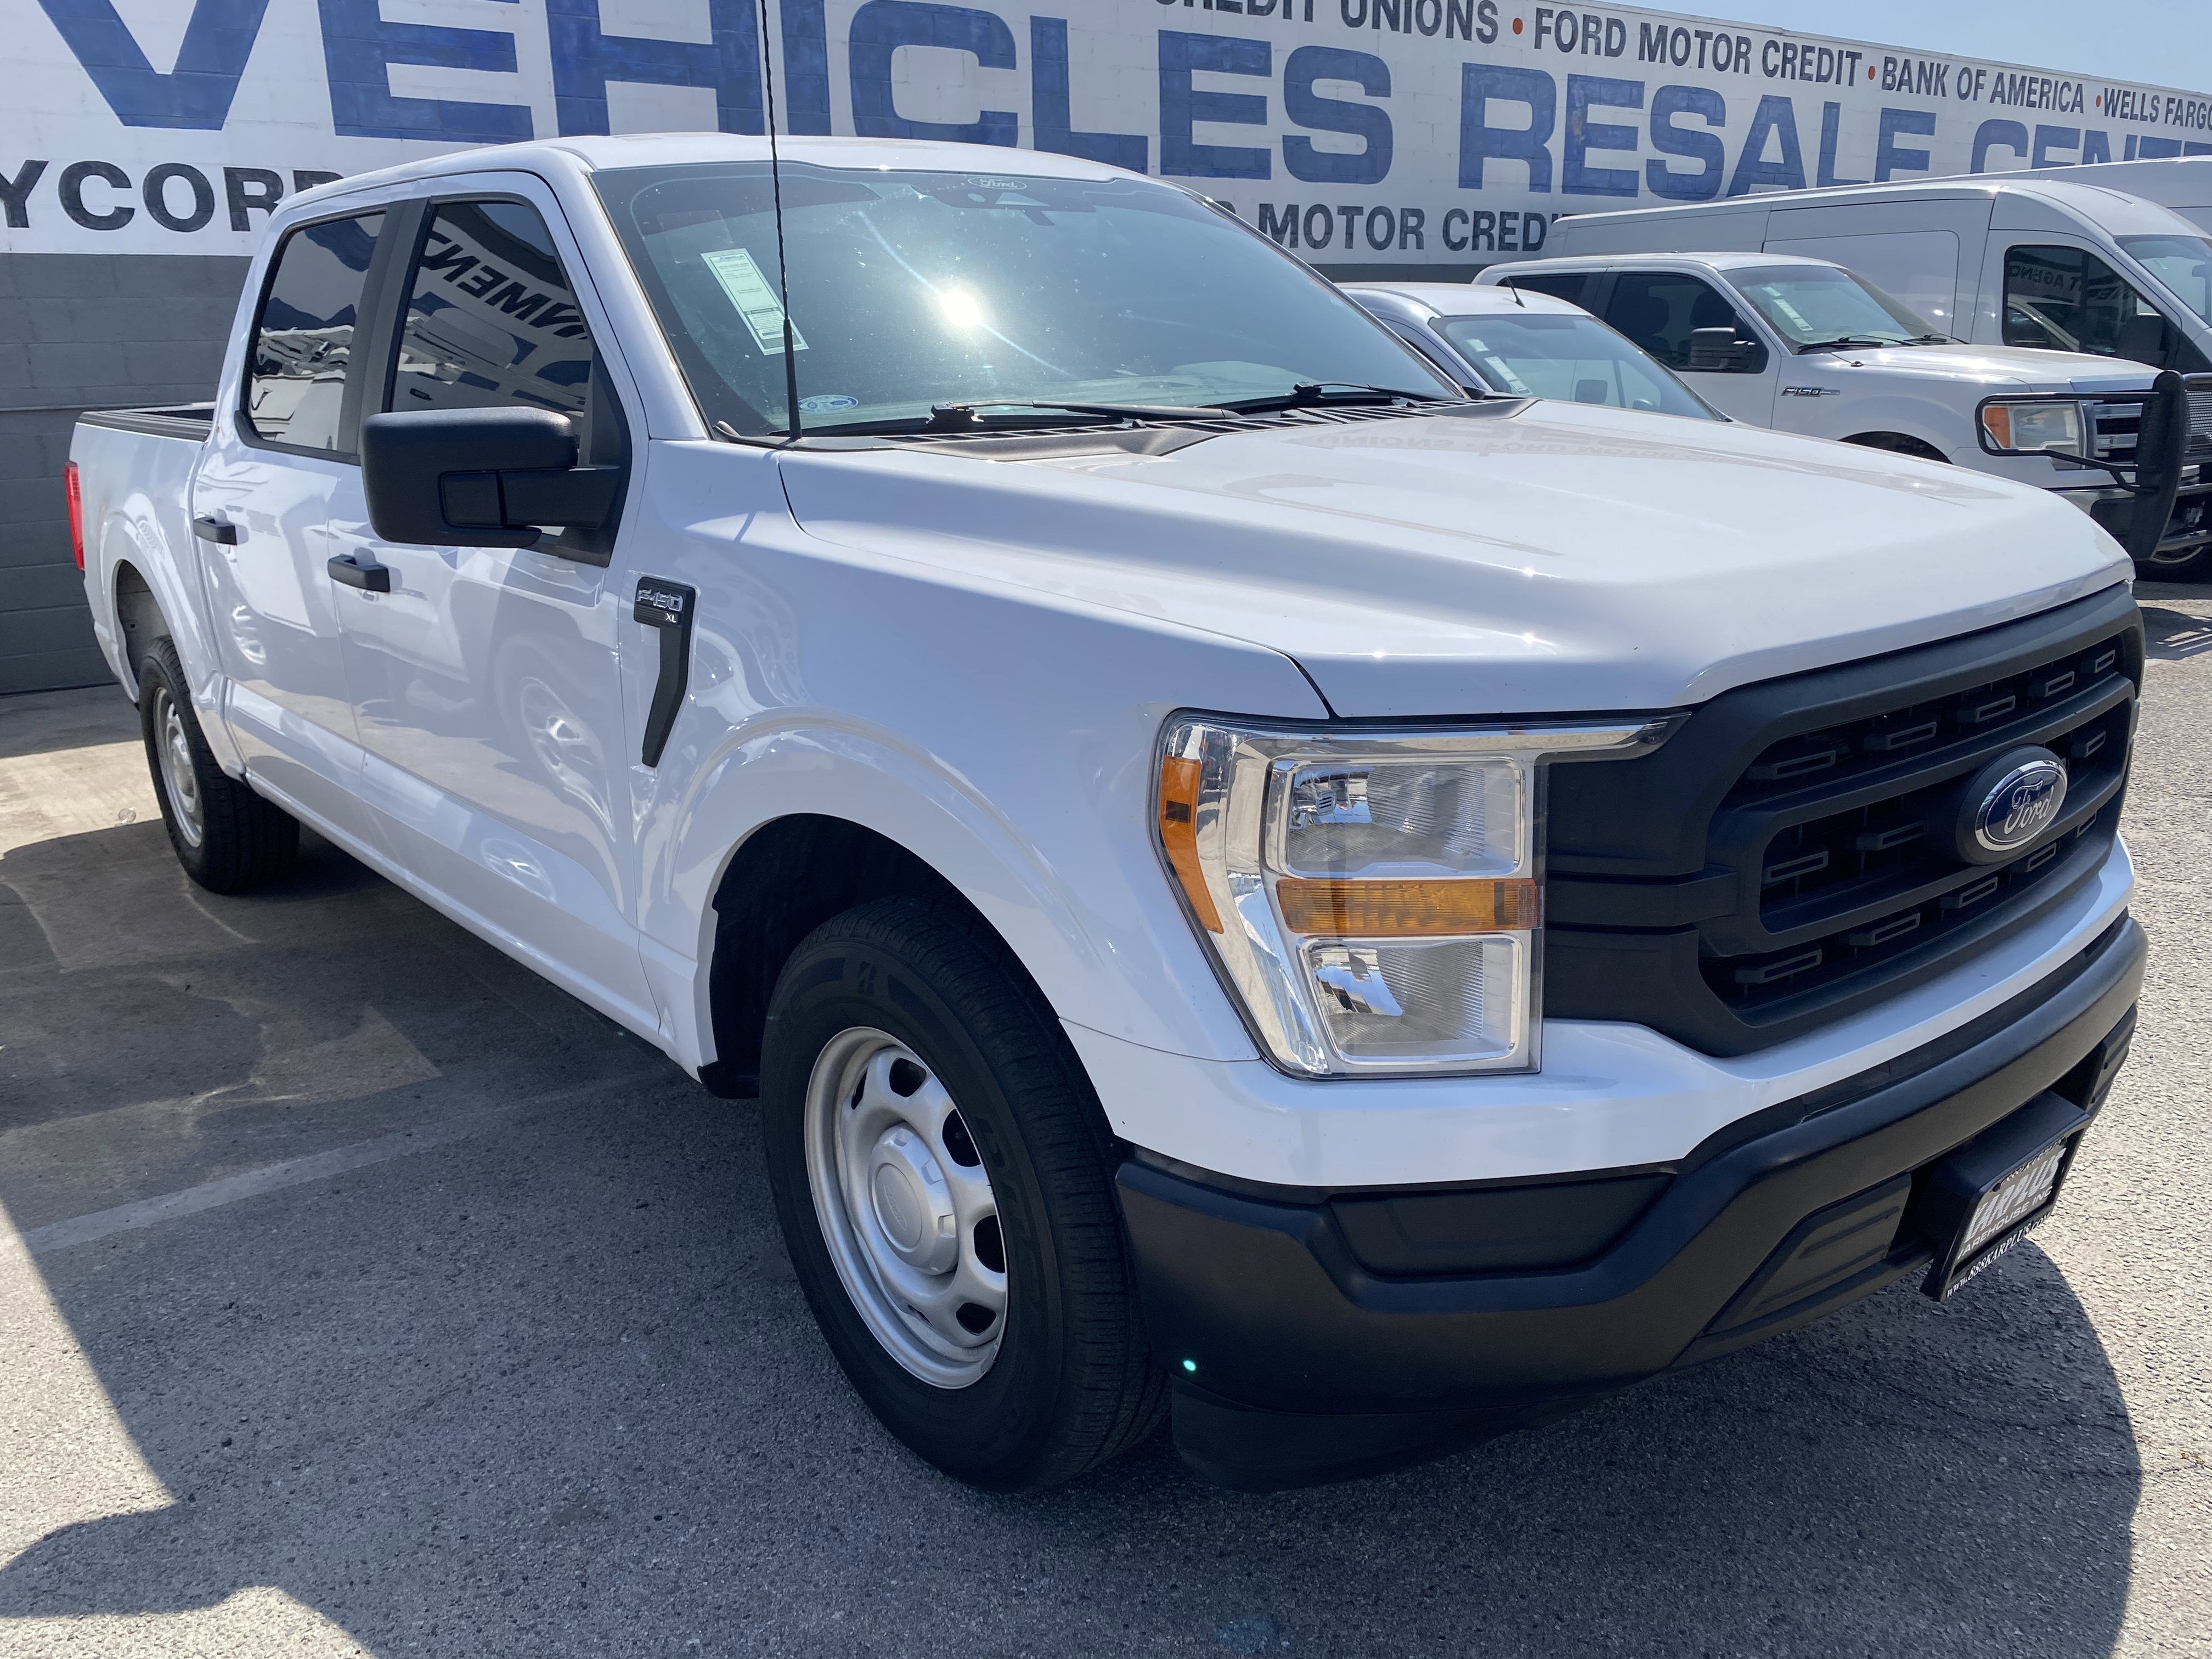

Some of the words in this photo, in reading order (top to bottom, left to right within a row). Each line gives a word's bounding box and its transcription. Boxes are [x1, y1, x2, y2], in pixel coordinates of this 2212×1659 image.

[1341, 0, 1498, 44] UNIONS
[1534, 7, 1627, 58] FORD
[1638, 22, 1751, 75] MOTOR
[1761, 39, 1863, 87] CREDIT
[1881, 55, 1950, 97] BANK
[1956, 66, 1987, 101] OF
[1989, 71, 2084, 114] AMERICA
[2104, 87, 2160, 123] WELLS
[37, 0, 1393, 185] VEHICLES
[1458, 62, 1937, 201] RESALE
[979, 178, 1018, 188] Ford
[1258, 202, 1425, 250] MOTOR
[1442, 207, 1580, 252] CRED
[665, 612, 677, 623] XL
[2004, 779, 2055, 835] Ford
[2032, 1186, 2053, 1206] INC
